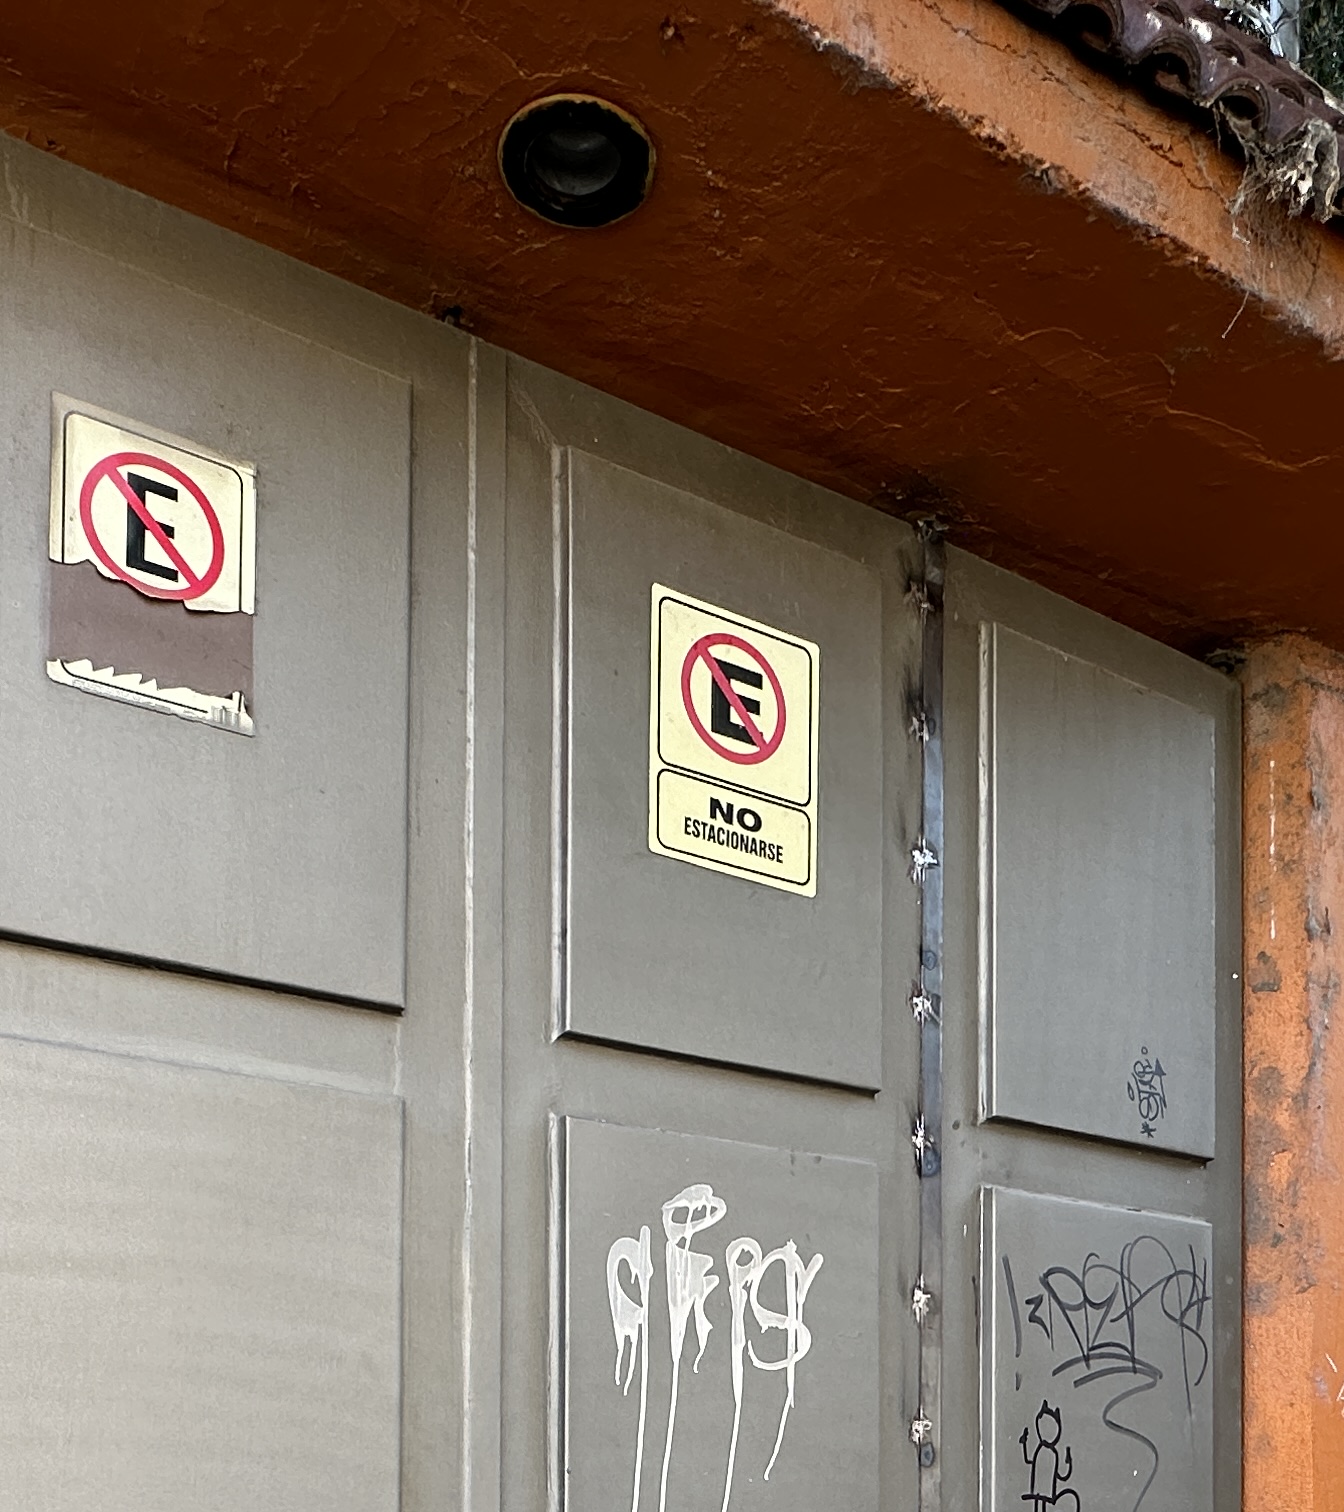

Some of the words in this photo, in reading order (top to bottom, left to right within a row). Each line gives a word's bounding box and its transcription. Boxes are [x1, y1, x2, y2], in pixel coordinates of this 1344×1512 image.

[126, 471, 178, 583] E
[711, 656, 763, 747] E
[684, 816, 784, 864] ESTACIONARSE
[709, 796, 763, 833] NO
